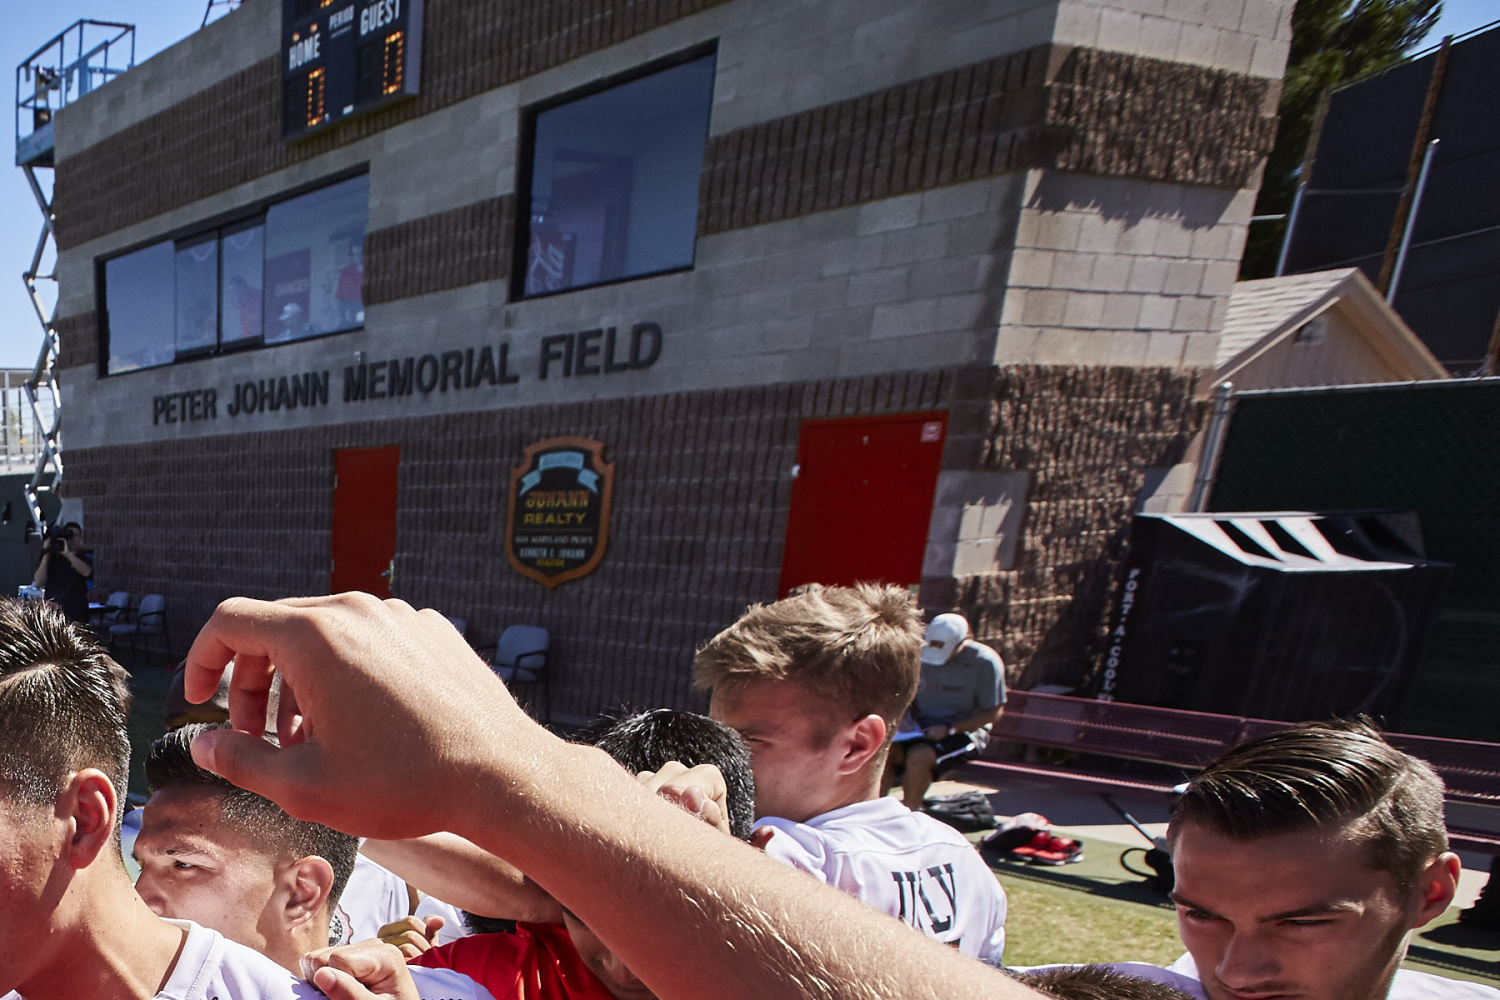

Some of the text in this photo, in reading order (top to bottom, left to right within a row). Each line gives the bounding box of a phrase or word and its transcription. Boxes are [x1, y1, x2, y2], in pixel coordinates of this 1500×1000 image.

[360, 0, 401, 36] GUEST
[289, 33, 321, 71] HOME
[383, 30, 404, 95] 0
[307, 67, 325, 127] 0
[153, 321, 663, 425] PETER JOHANN MEMORIAL FIELD
[524, 512, 586, 525] REALTY
